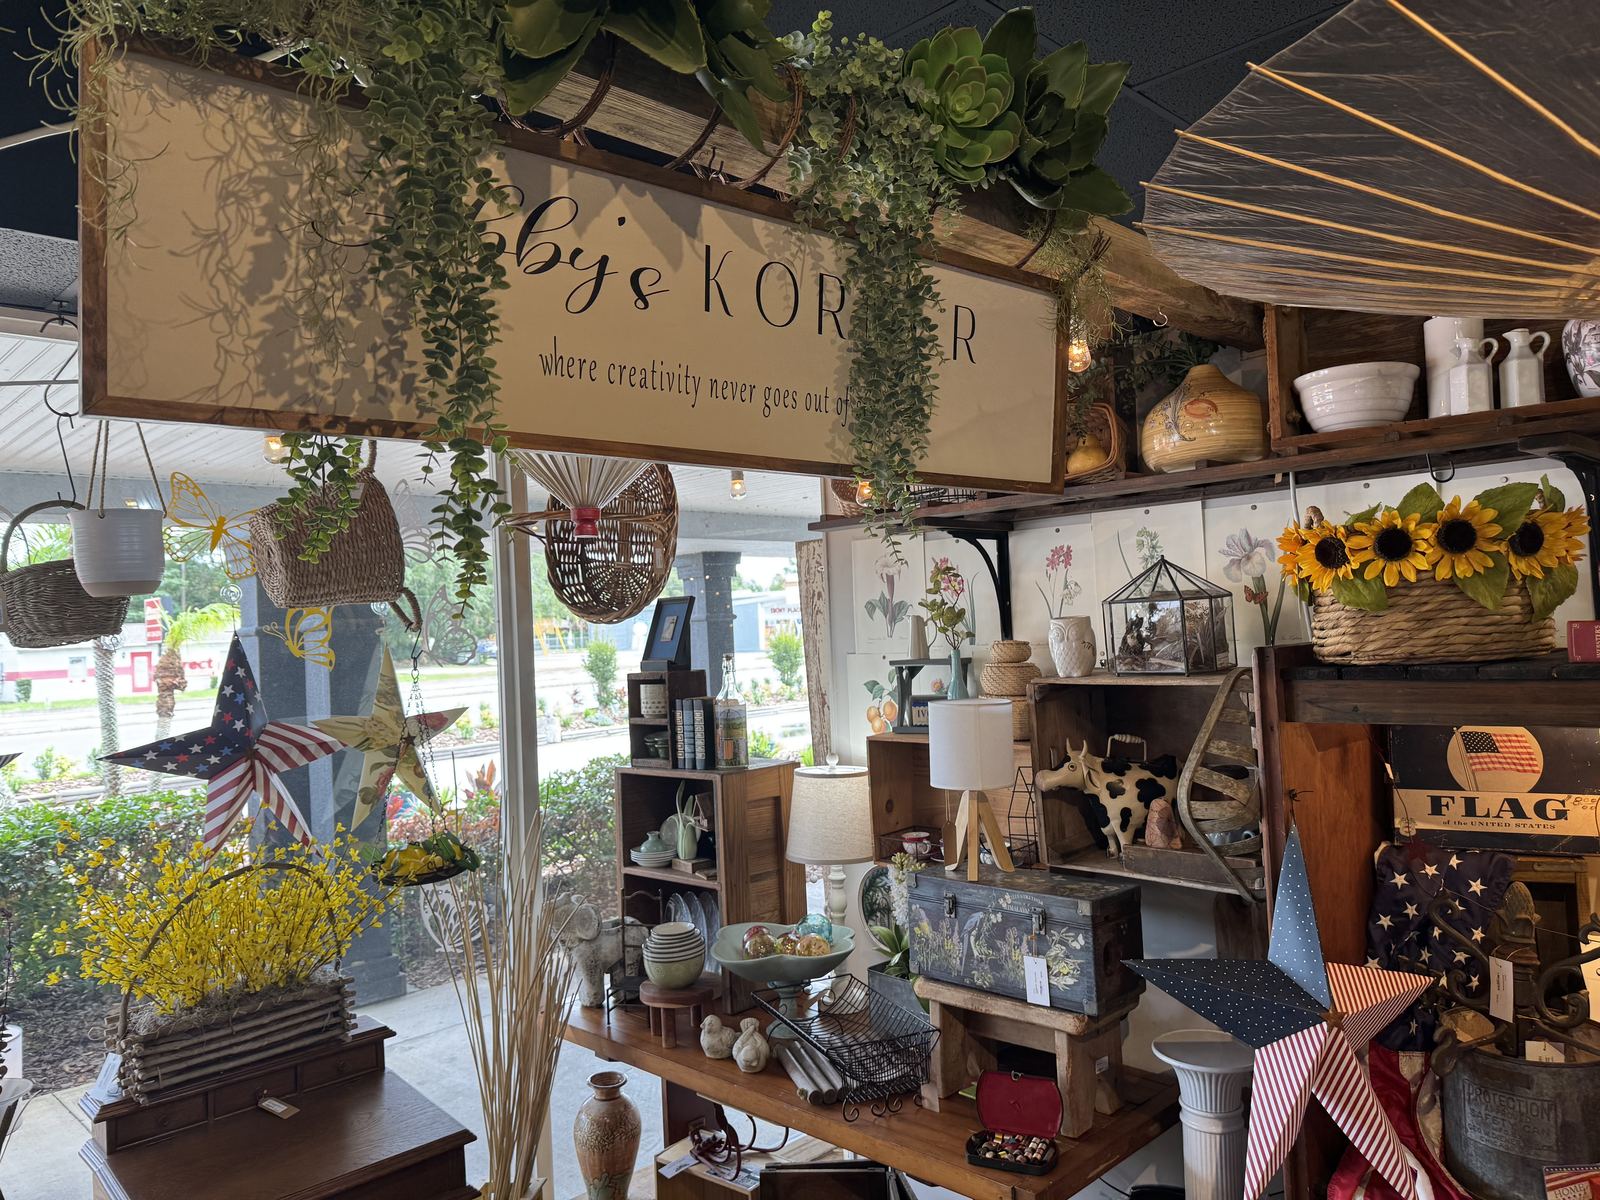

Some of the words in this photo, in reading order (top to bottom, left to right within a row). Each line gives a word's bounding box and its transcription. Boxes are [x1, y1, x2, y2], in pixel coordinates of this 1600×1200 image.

[703, 244, 977, 365] KORR
[538, 335, 597, 382] where
[607, 359, 701, 408] creativity
[709, 378, 756, 404] never
[762, 385, 798, 418] goes
[805, 386, 829, 414] out
[836, 385, 850, 427] of
[182, 658, 213, 669] rect
[1426, 794, 1570, 821] FLAG
[1470, 820, 1511, 828] UNITED
[1514, 822, 1556, 830] STATES
[1467, 1083, 1553, 1121] PROTECTION
[1554, 1183, 1585, 1199] HOME
